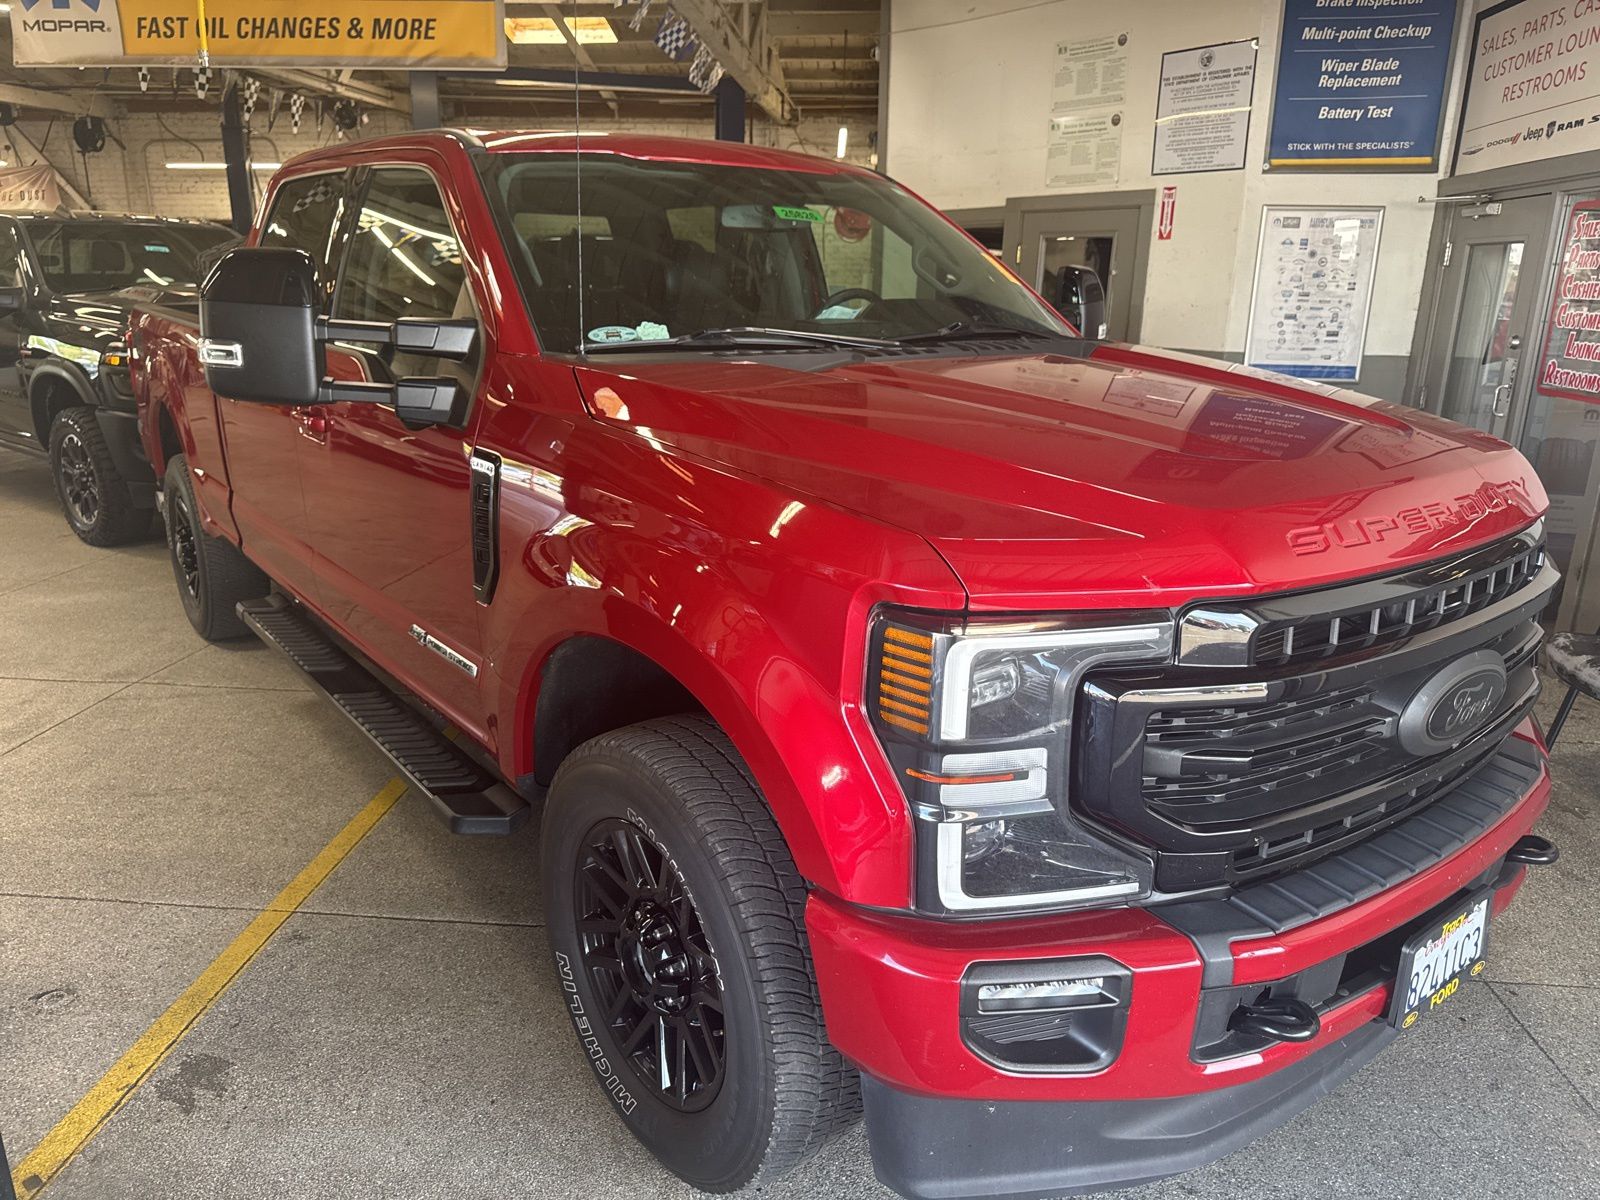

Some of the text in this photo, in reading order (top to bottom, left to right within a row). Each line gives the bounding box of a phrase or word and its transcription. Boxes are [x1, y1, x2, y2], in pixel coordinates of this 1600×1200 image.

[137, 17, 437, 40] FAST OIL CHANGES & MORE
[1301, 24, 1432, 42] Multi-point Checkup
[1482, 27, 1518, 56] SALES,
[1523, 7, 1567, 39] PARTS,
[1321, 57, 1400, 74] Wiper Blade
[1484, 42, 1554, 82] CUSTOMER
[1318, 74, 1402, 90] Replacement
[1502, 61, 1588, 103] RESTROOMS
[1318, 105, 1394, 121] Battery Test
[1557, 118, 1584, 132] RAM
[1287, 143, 1312, 151] STICK
[1313, 143, 1335, 151] WITH
[1338, 143, 1354, 151] THE
[1523, 127, 1544, 141] Jeep
[1573, 212, 1600, 239] SALE
[1562, 273, 1600, 299] CASHIE
[1285, 476, 1533, 557] SUPER DUTY
[1445, 681, 1495, 732] Ford
[1429, 977, 1459, 1010] FORD
[555, 951, 637, 1116] MICHELIN
